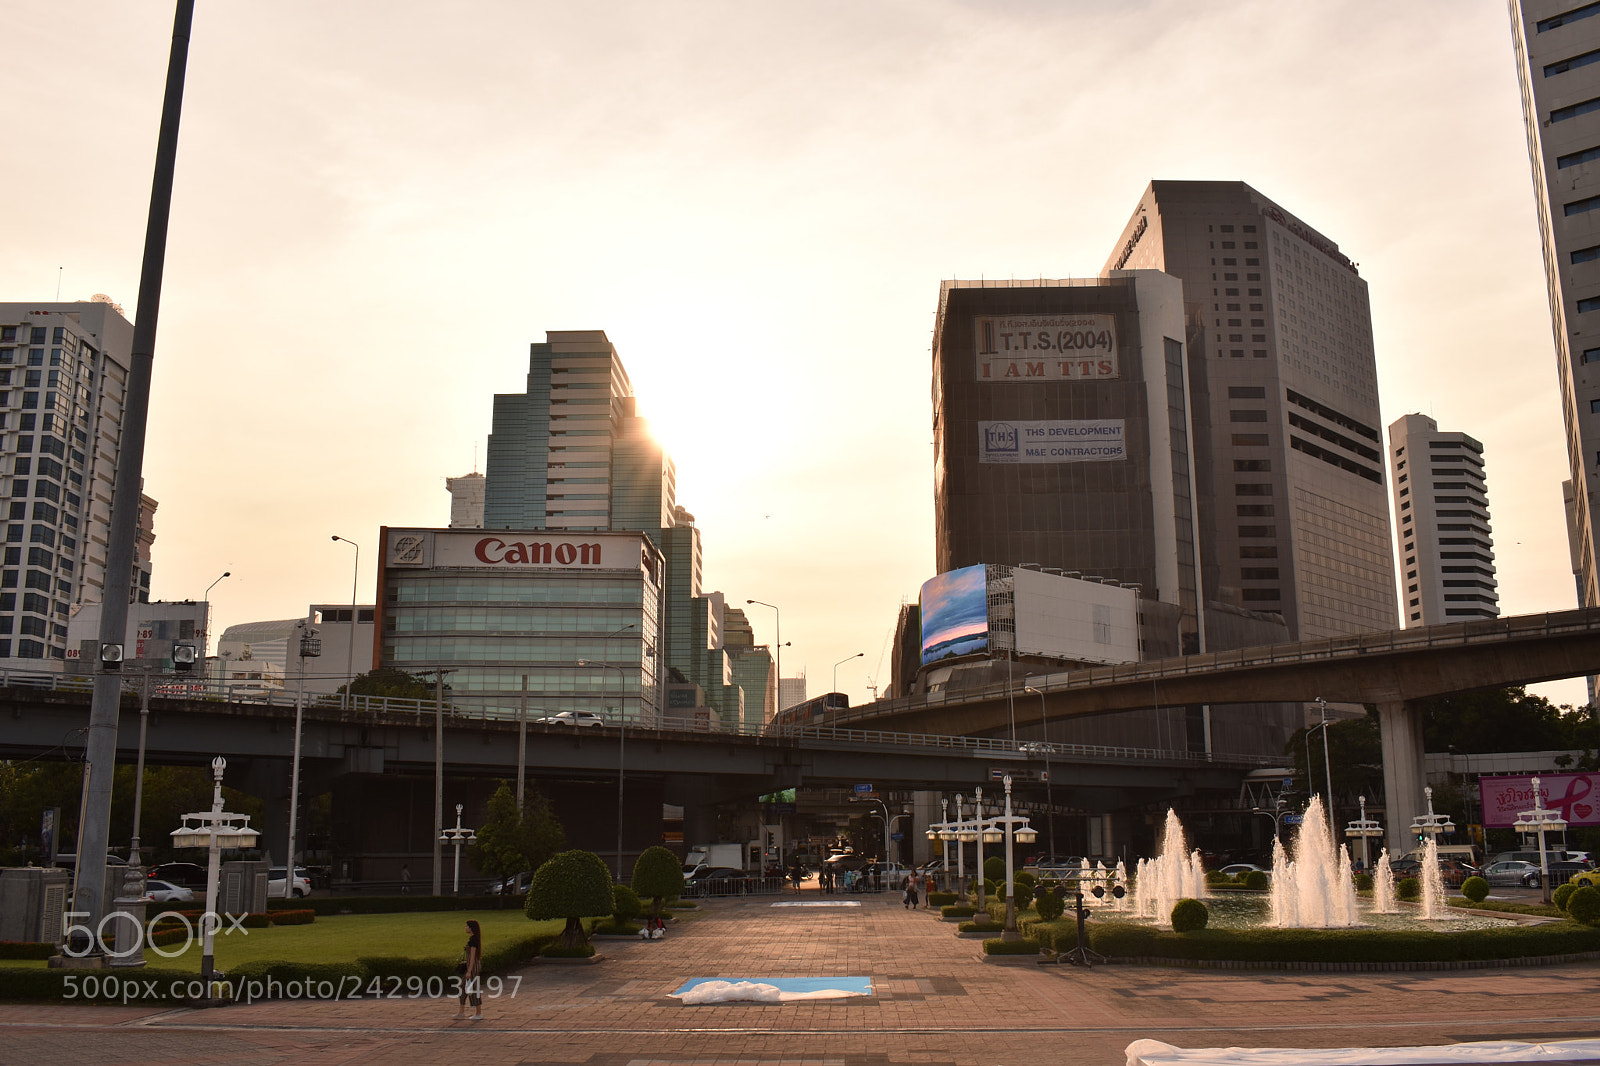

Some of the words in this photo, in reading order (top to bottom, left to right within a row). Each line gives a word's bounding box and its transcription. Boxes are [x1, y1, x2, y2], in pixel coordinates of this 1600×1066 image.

[1000, 330, 1113, 353] T.T.S.(2004)
[982, 363, 991, 377] I
[1004, 361, 1046, 377] AM
[1057, 360, 1113, 376] TTS
[989, 432, 1014, 442] THS
[1025, 428, 1045, 436] THS
[1049, 426, 1122, 436] DEVELOPMENT
[1025, 448, 1047, 457] M&E
[1050, 447, 1123, 456] CONTRACTORS
[474, 537, 602, 565] Canon
